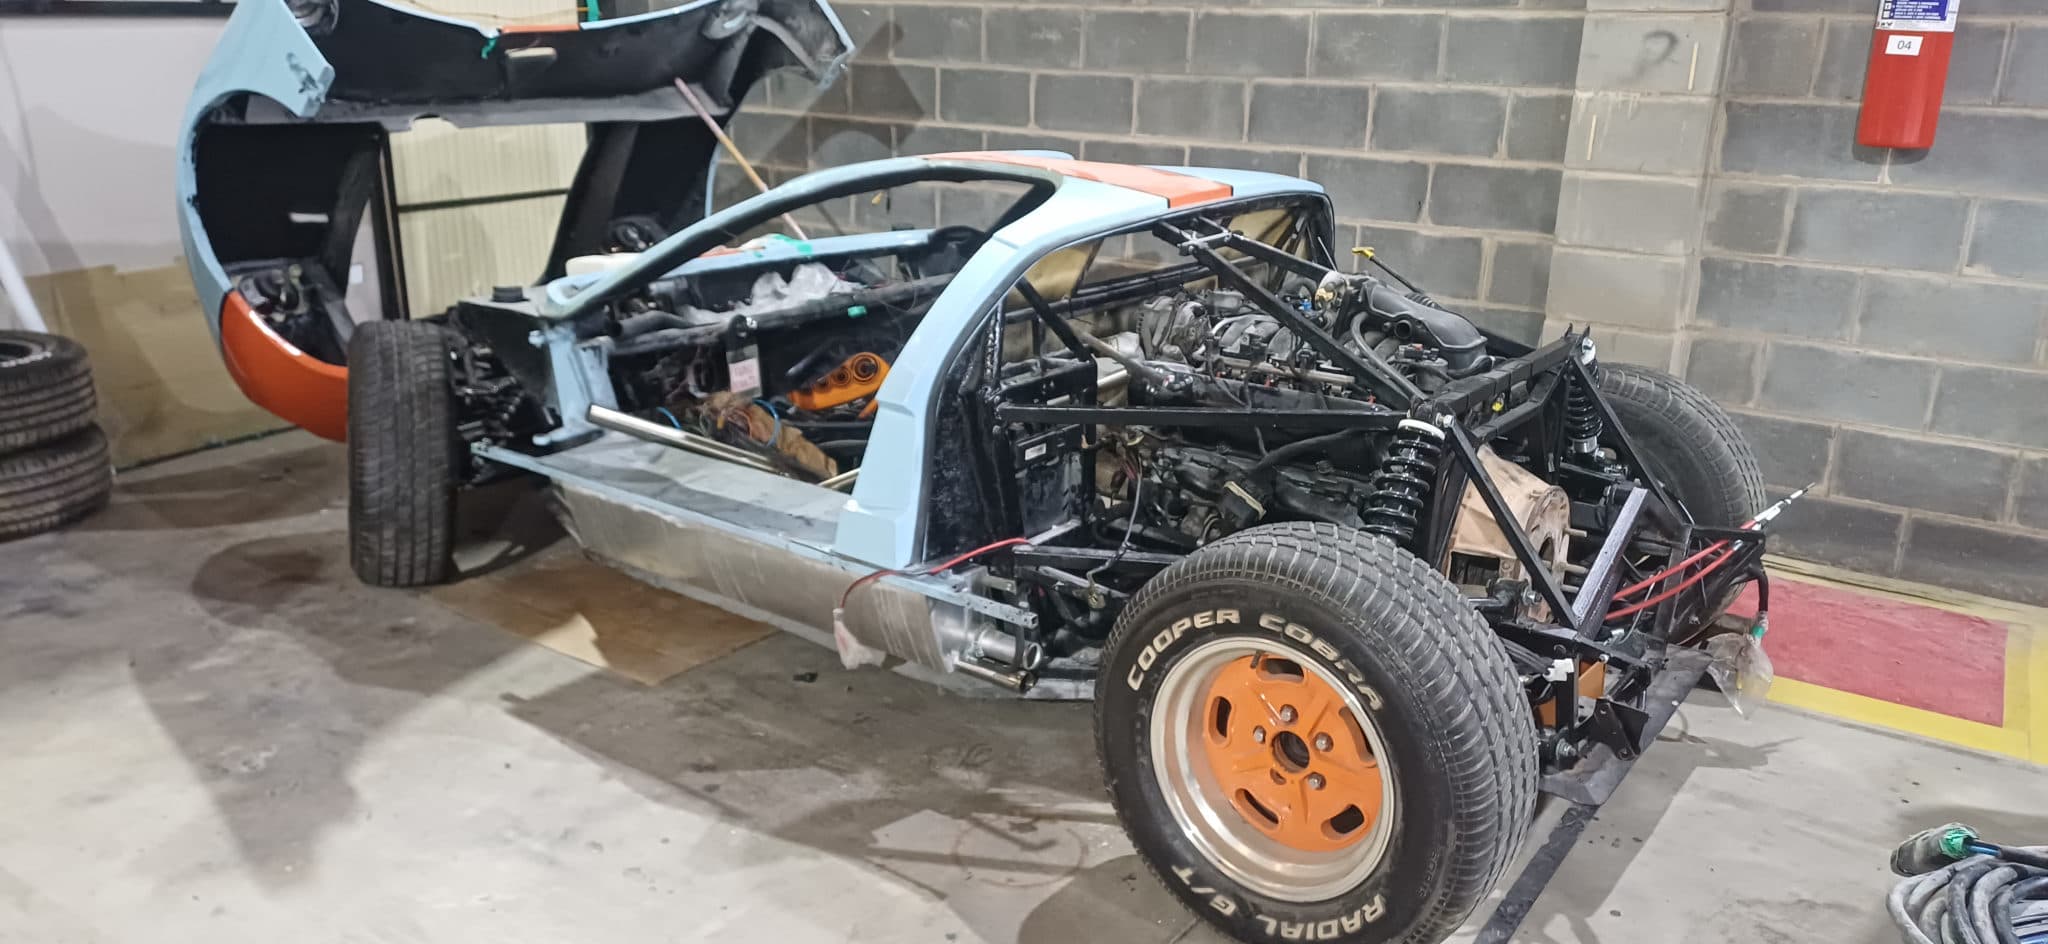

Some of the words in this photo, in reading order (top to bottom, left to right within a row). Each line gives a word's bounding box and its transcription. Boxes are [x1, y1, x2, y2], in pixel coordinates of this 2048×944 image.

[1897, 40, 1912, 50] 04
[1127, 609, 1241, 691] COOPER
[1258, 612, 1384, 711] COBRA
[1171, 864, 1237, 917] G/T
[1256, 893, 1387, 940] RADIAL
